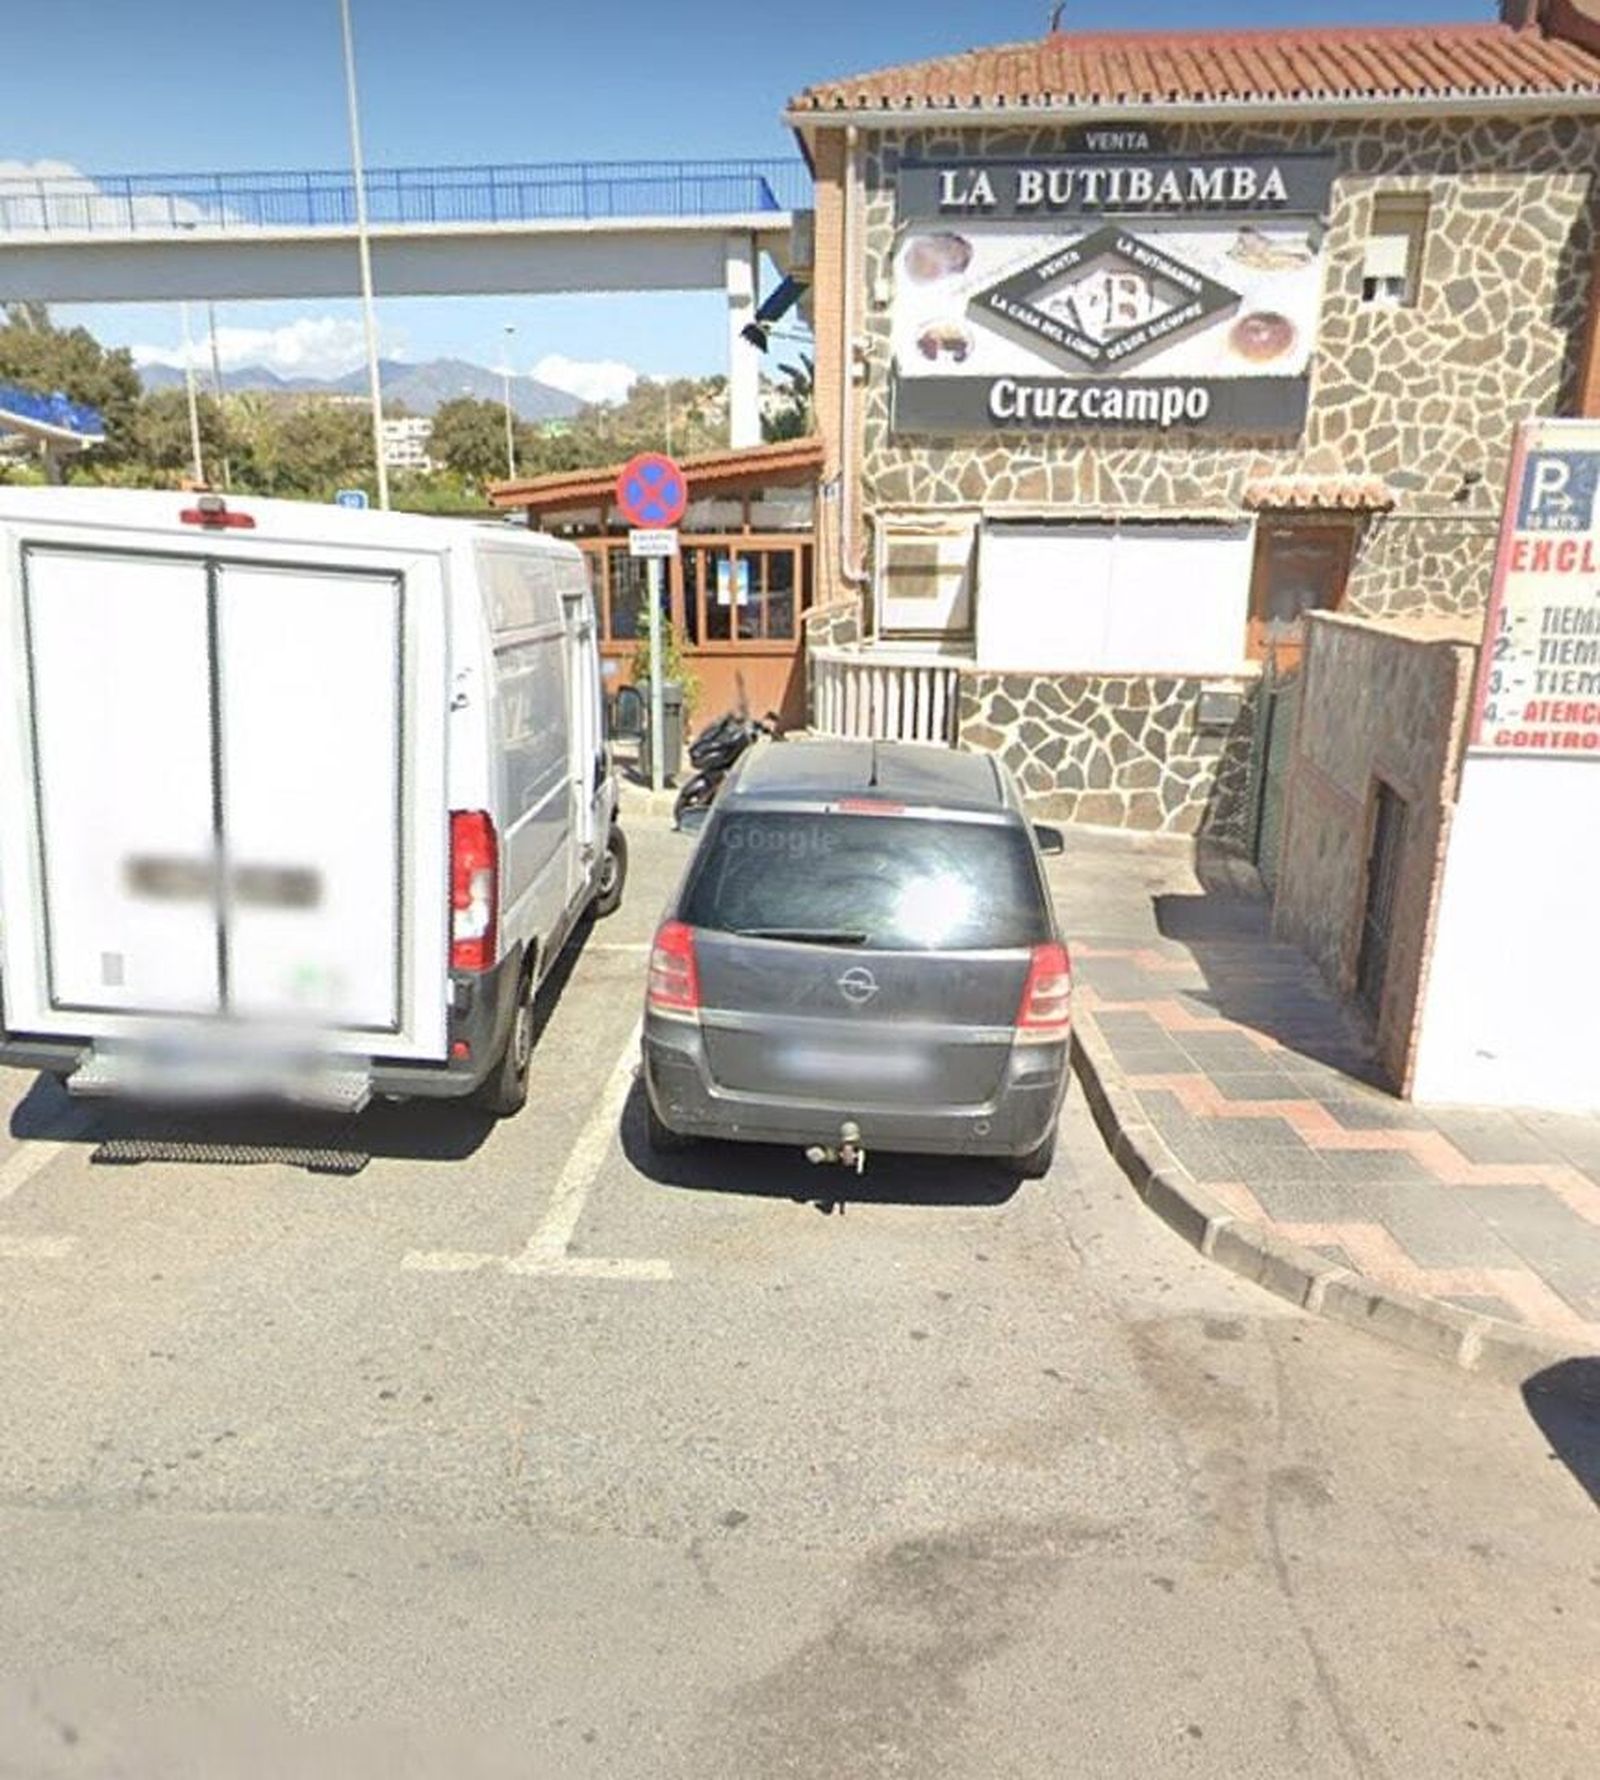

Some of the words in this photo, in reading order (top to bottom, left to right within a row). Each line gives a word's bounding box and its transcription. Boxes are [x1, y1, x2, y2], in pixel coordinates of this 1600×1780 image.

[1086, 132, 1149, 150] VENTA
[940, 170, 997, 205] LA
[1017, 166, 1289, 204] BUTIBAMBA
[990, 379, 1209, 426] Cruzcampo
[1530, 458, 1571, 511] P
[1510, 540, 1597, 573] EXCL
